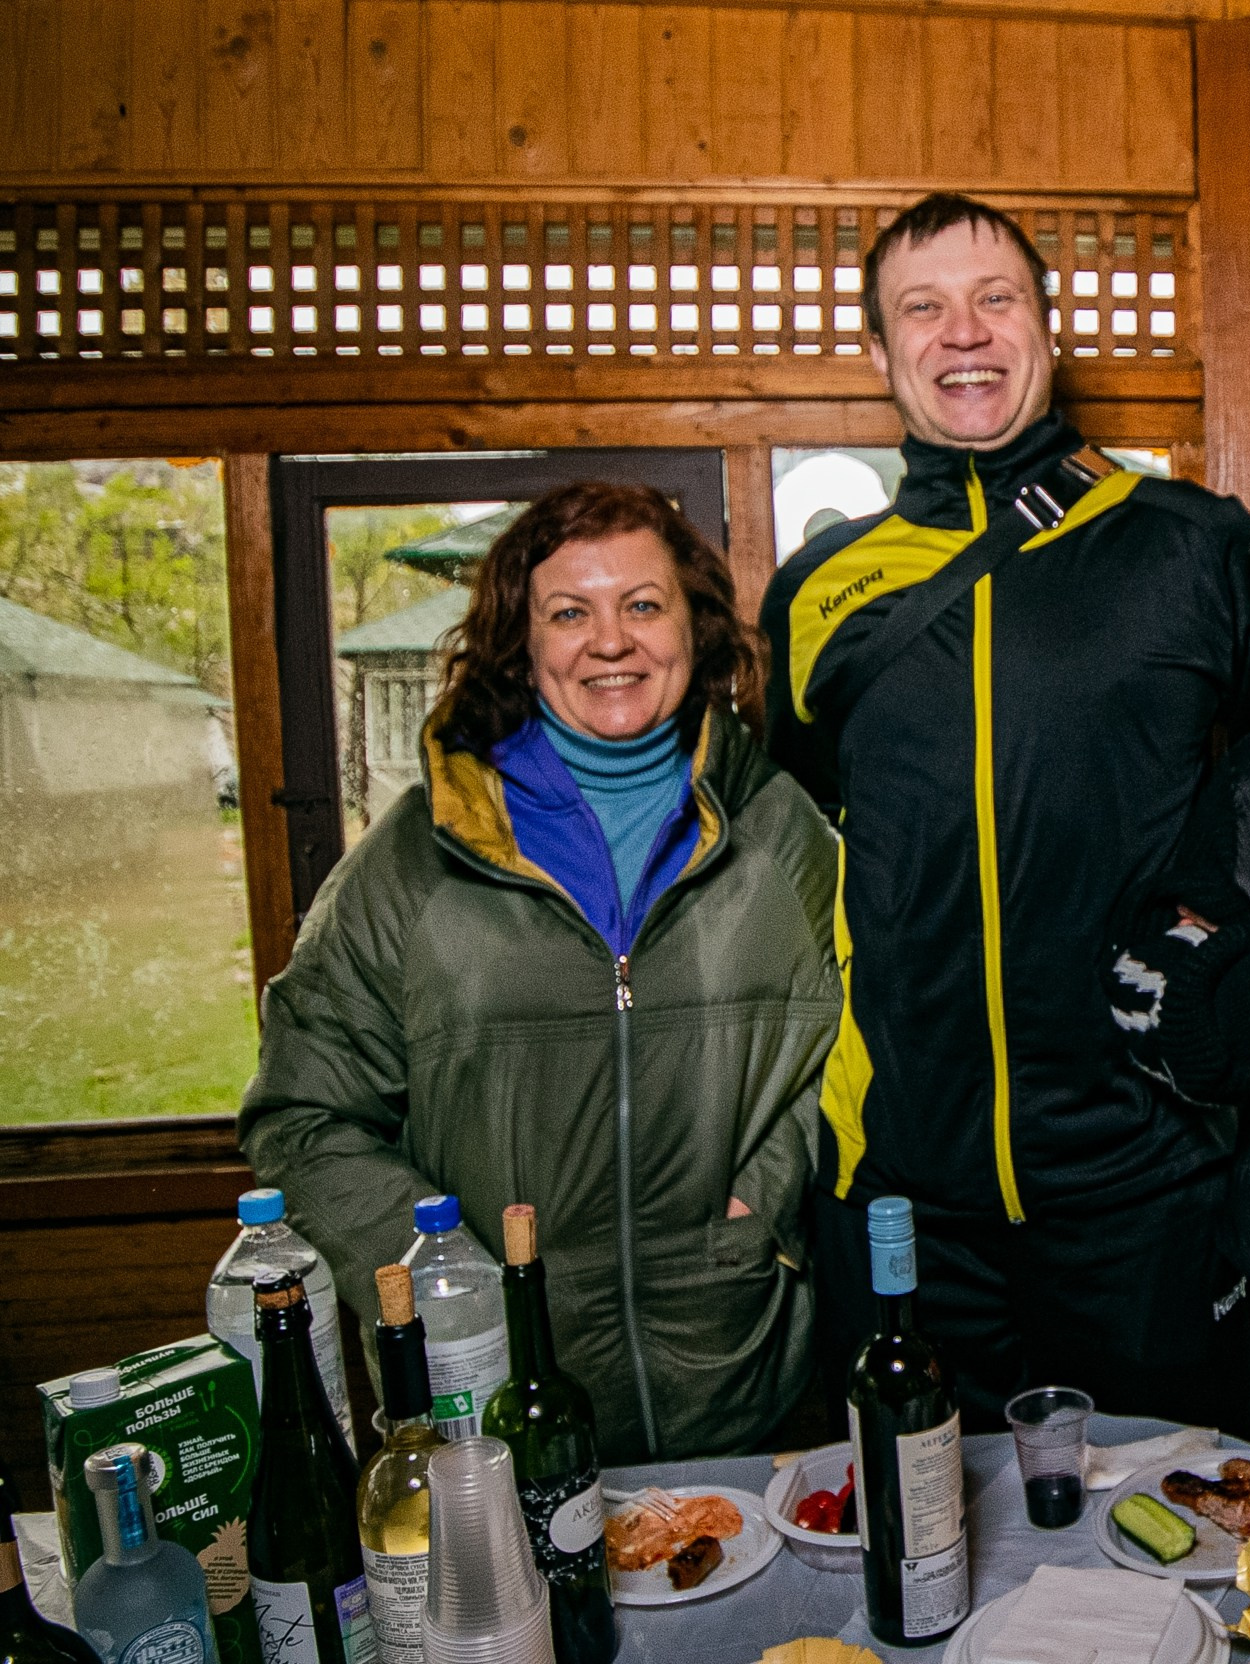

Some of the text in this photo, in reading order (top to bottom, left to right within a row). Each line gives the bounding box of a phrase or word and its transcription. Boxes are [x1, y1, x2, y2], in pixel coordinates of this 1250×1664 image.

[819, 568, 884, 620] Kempa
[118, 1349, 176, 1375] МУЛЬТИФ
[135, 1385, 196, 1419] БОЛЬШЕ
[125, 1405, 182, 1435] ПОЛЬЗЫ
[179, 1433, 236, 1456] КАК ПОЛУЧИТЬ
[180, 1448, 212, 1463] БОЛЬШЕ
[181, 1449, 230, 1470] ЖИЗНЕННЫХ
[155, 1492, 210, 1524] ОЛЬШЕ
[191, 1504, 219, 1522] СИЛ
